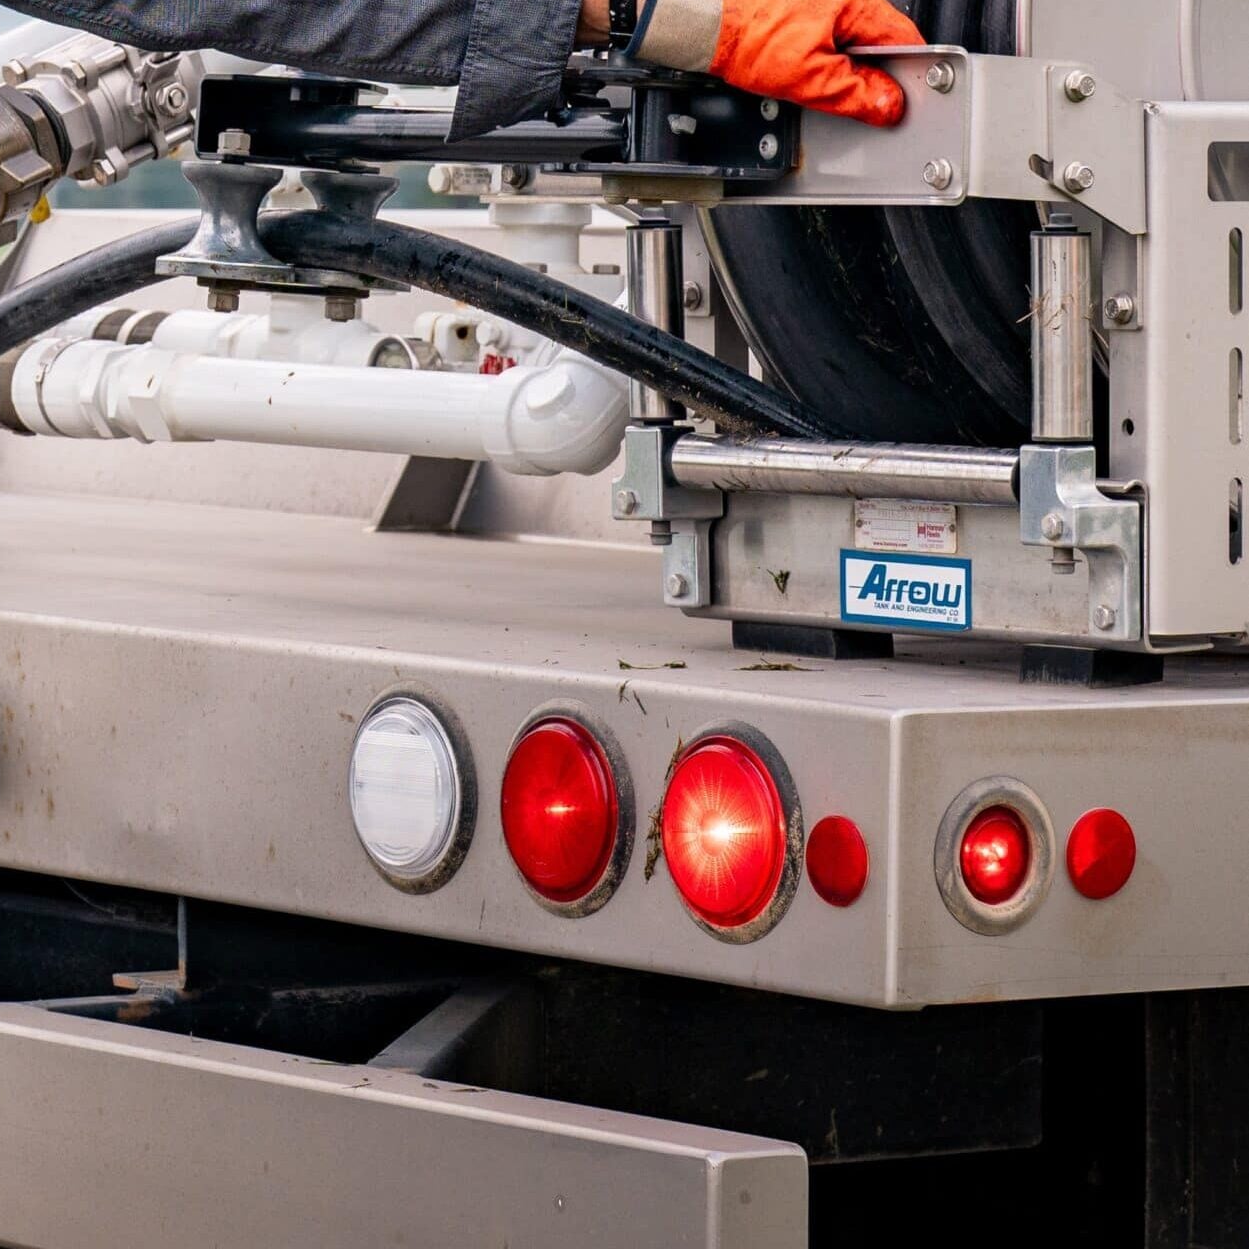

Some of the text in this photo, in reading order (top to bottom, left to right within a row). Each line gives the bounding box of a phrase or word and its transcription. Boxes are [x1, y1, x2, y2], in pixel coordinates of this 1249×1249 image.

[857, 563, 962, 608] Arrow
[874, 602, 889, 610] TANK
[891, 603, 904, 611] AND
[907, 605, 947, 615] ENGINEERING
